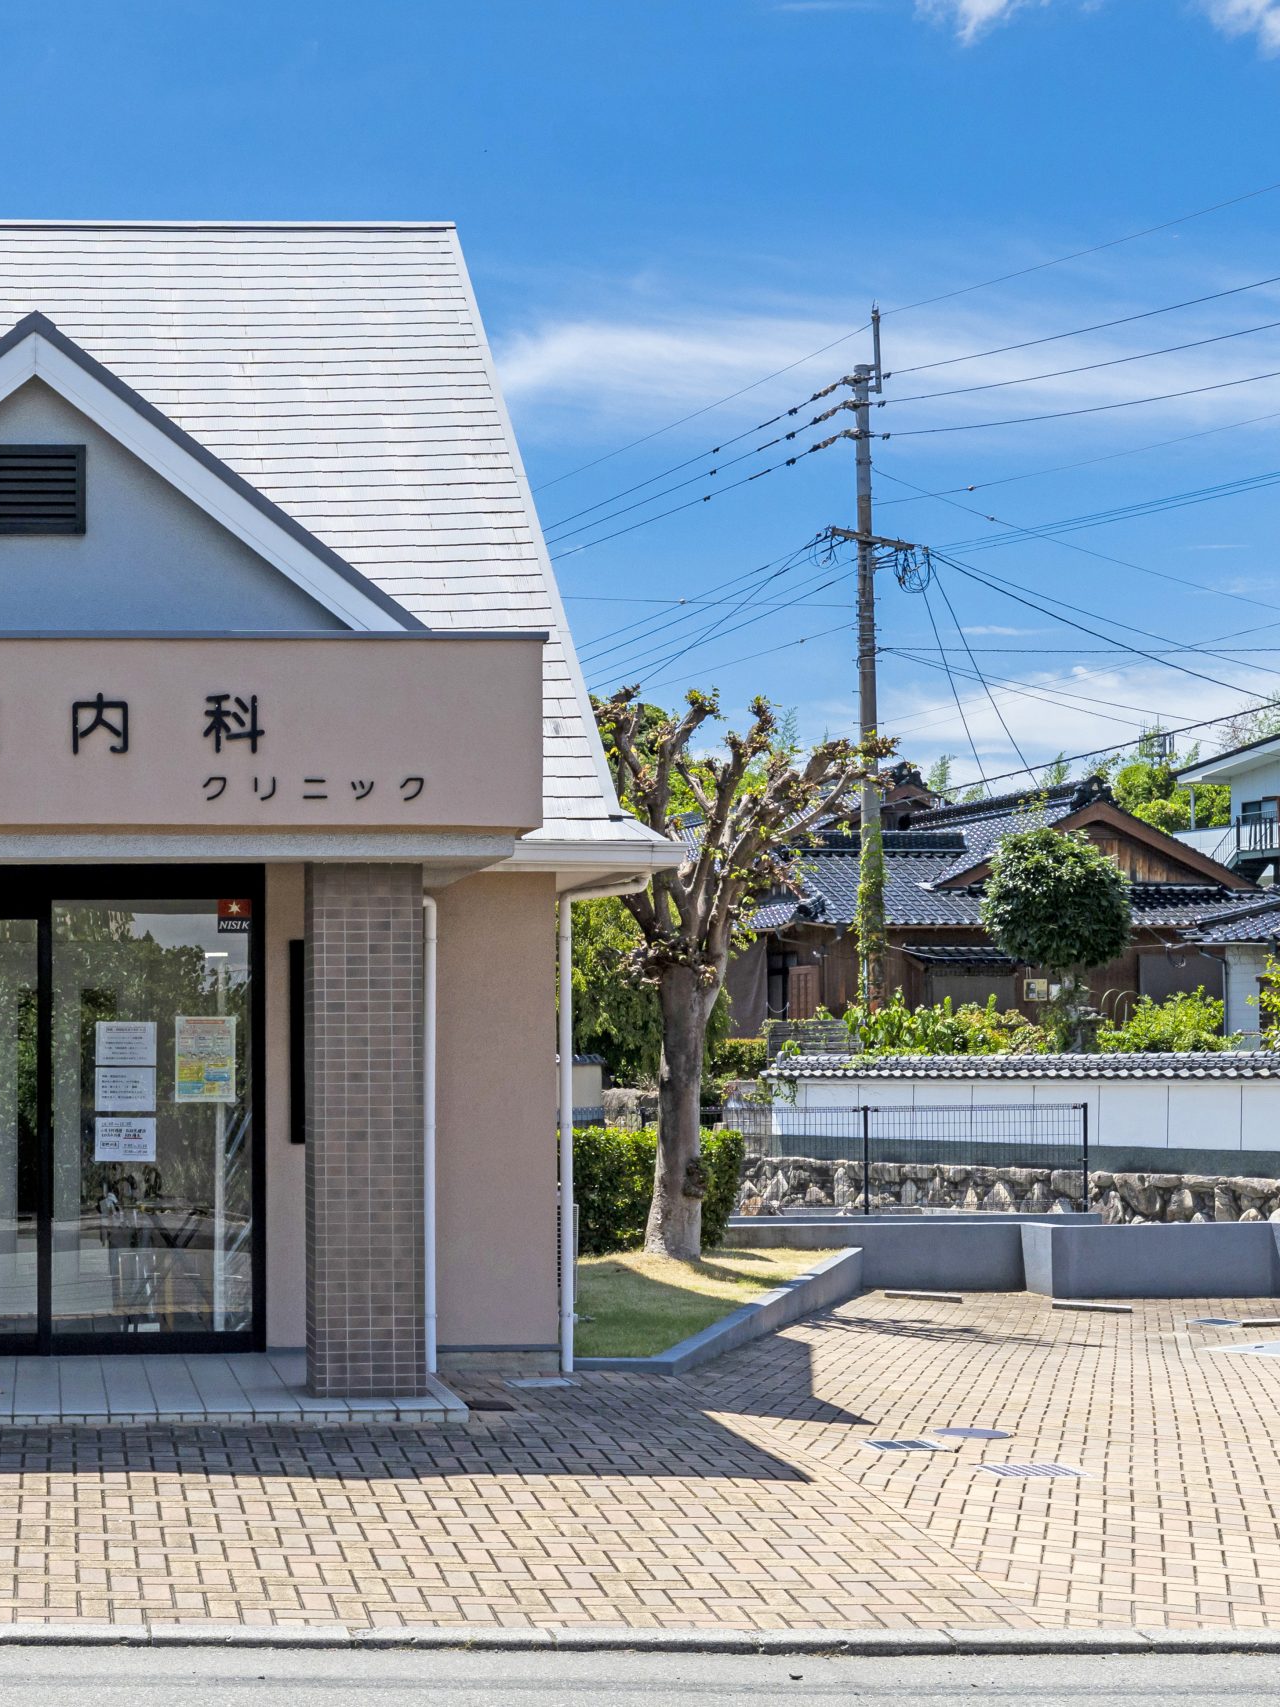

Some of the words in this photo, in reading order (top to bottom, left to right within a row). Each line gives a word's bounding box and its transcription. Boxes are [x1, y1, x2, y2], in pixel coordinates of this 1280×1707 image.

[202, 775, 425, 801] クリニック
[218, 920, 250, 930] NISIK
